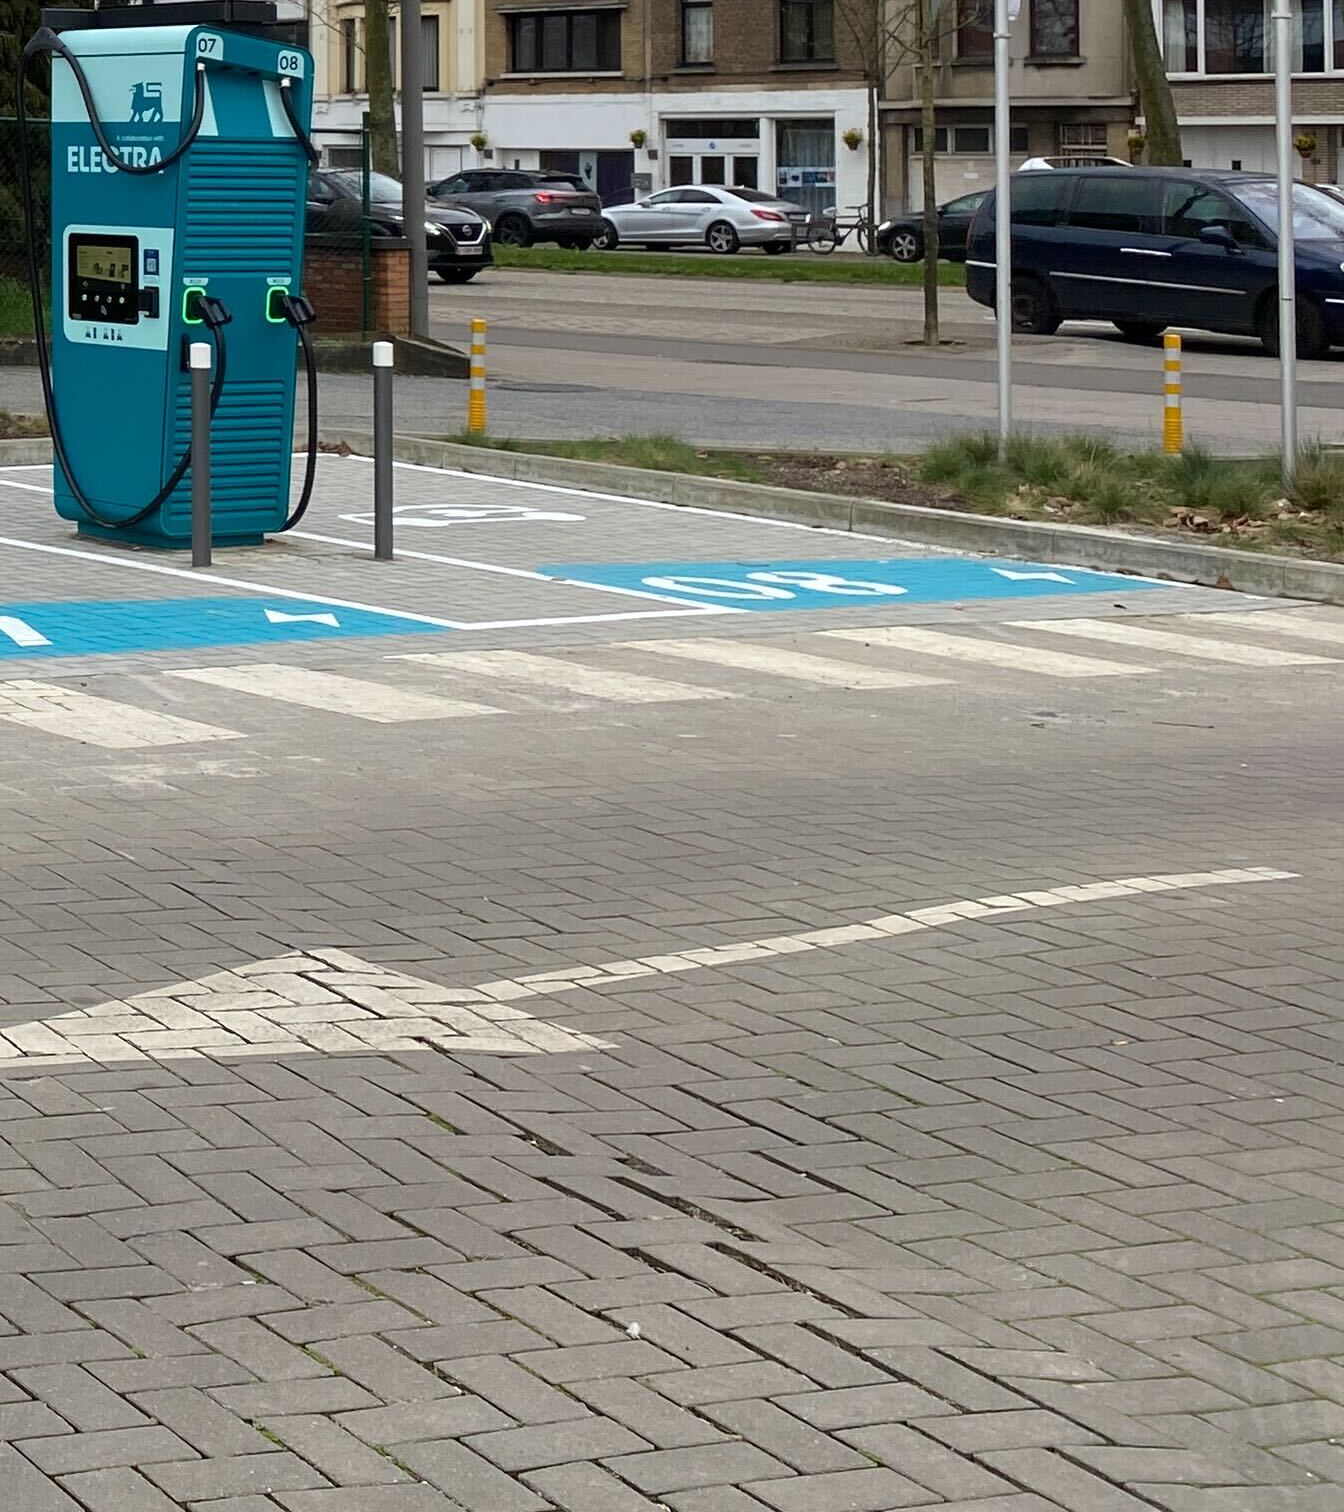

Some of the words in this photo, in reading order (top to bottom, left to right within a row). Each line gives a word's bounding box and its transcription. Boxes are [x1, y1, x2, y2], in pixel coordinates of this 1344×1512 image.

[198, 38, 217, 53] 07
[279, 55, 298, 71] 08
[67, 146, 164, 174] ELECTRA
[641, 571, 909, 600] 08
